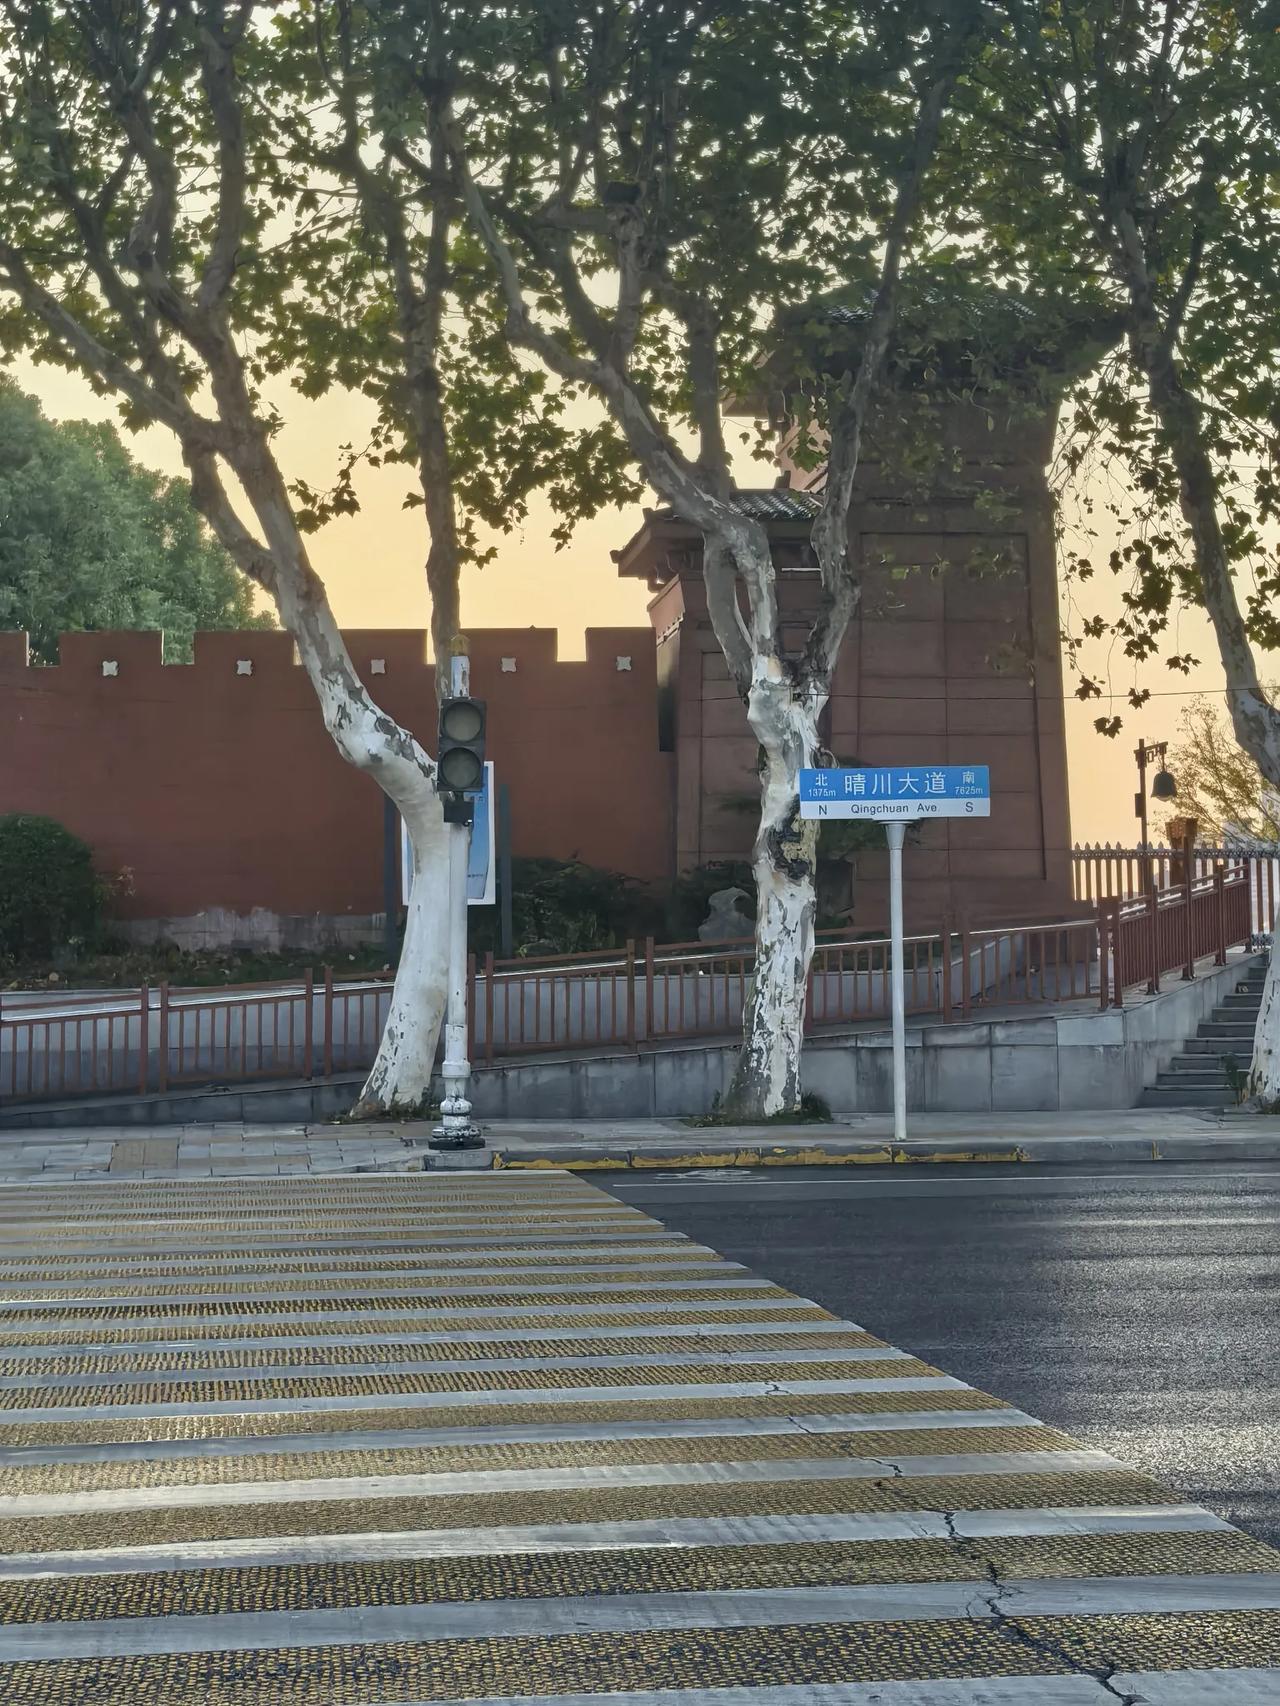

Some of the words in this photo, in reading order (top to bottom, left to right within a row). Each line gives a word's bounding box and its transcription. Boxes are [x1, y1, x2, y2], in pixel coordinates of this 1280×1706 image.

[815, 773, 828, 787] 北
[844, 771, 946, 795] 晴川大道
[962, 770, 975, 785] 南
[808, 788, 836, 797] 1375m
[818, 804, 828, 815] N
[850, 803, 909, 815] Qingchuan
[965, 801, 974, 813] S
